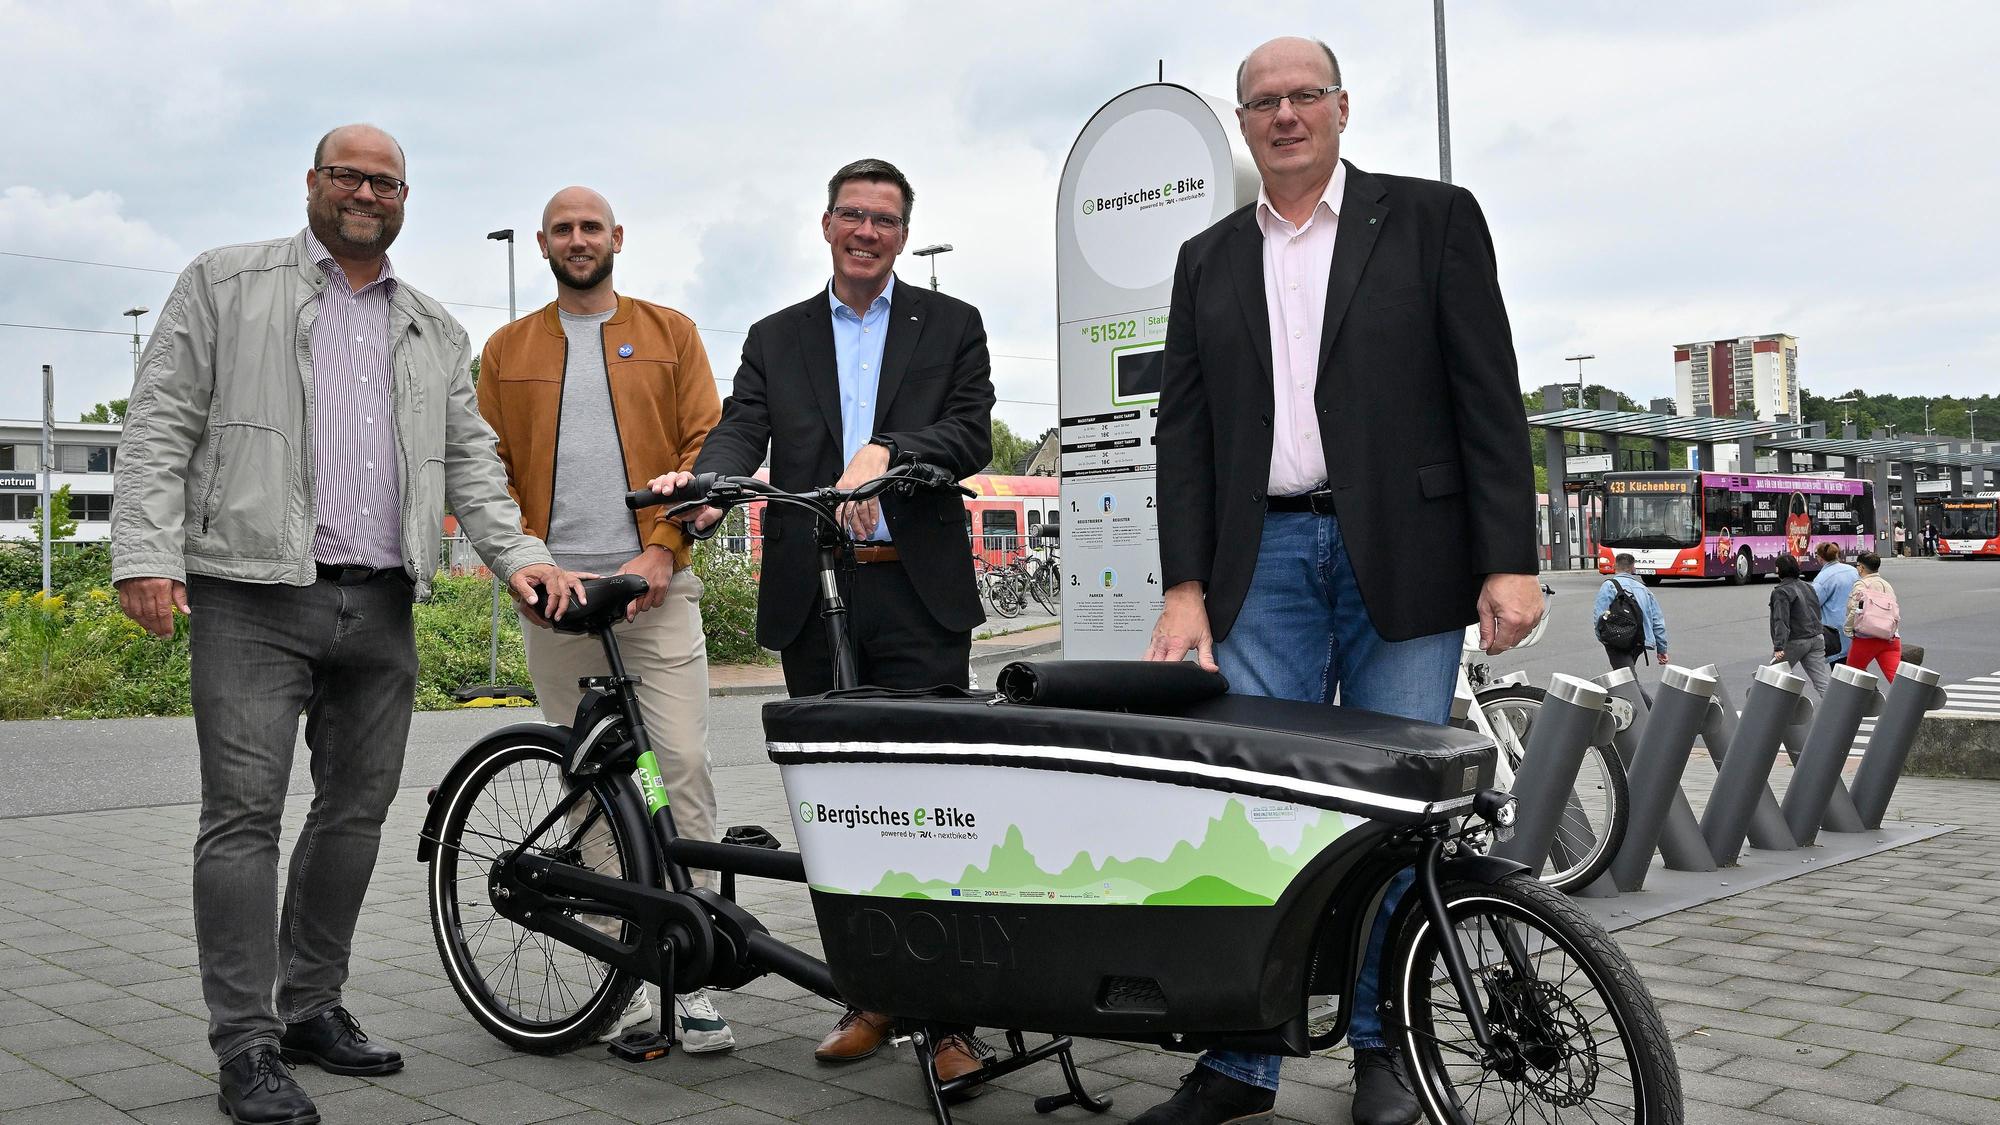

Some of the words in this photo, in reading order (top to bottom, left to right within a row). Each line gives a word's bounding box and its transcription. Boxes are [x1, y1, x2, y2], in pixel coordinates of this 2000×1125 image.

[1097, 188, 1161, 211] Bergisches
[1163, 178, 1205, 197] e-Bike
[1140, 202, 1158, 211] powered
[1090, 320, 1136, 343] 51522
[1610, 481, 1626, 493] 433
[1629, 481, 1687, 492] Küchenberg
[1070, 501, 1080, 512] 1.
[1146, 496, 1156, 508] 2.
[974, 511, 980, 523] 2
[1070, 574, 1080, 586] 3.
[1146, 572, 1158, 585] 4.
[816, 804, 910, 829] Bergisches
[913, 807, 976, 827] e-Bike
[909, 830, 916, 839] by
[938, 832, 967, 840] nextbike
[863, 908, 1027, 969] DOLLY
